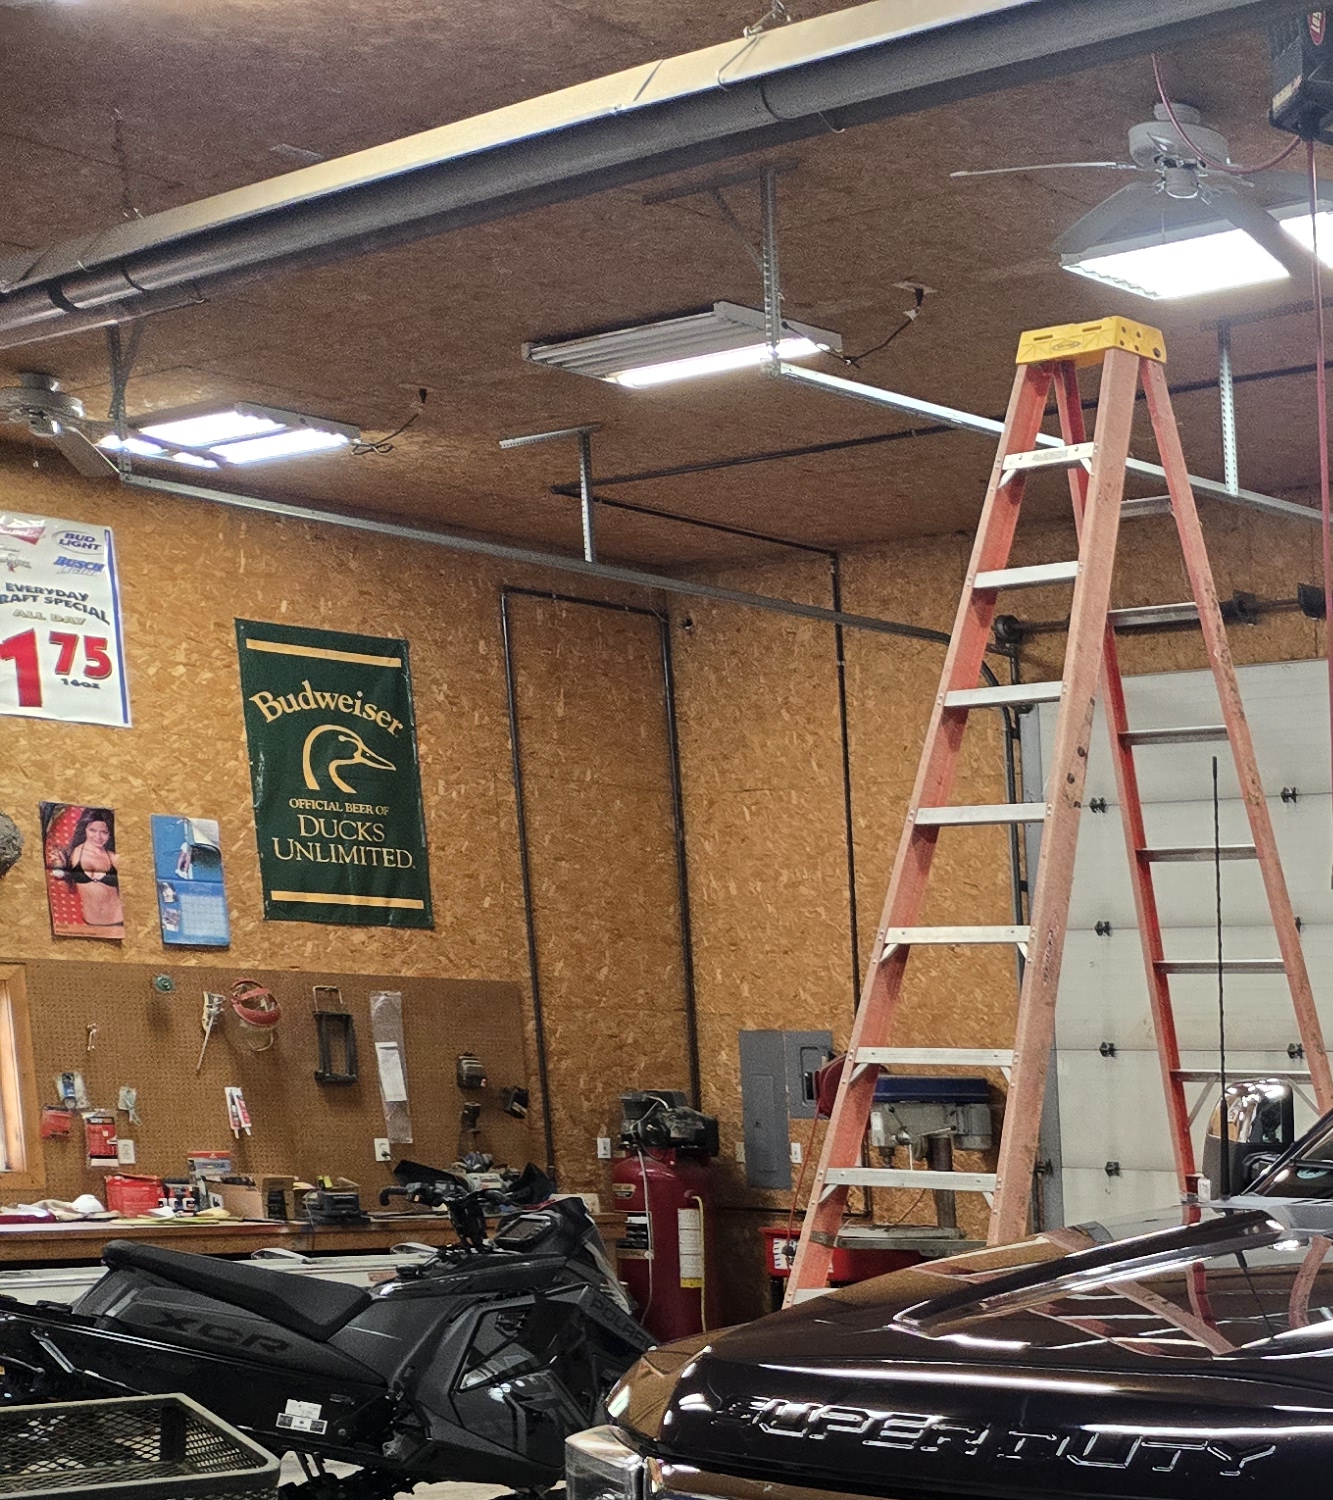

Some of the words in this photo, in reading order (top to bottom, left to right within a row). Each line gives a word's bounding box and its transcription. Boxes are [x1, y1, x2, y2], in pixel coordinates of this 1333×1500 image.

[59, 538, 102, 551] LIGHT
[64, 532, 96, 543] BUD
[53, 555, 105, 572] BUSCH
[5, 582, 89, 601] EVERYDAY
[13, 608, 47, 621] ALL
[50, 613, 86, 626] DAY
[44, 596, 110, 625] SPECIAL
[249, 679, 404, 738] Budweiser
[289, 798, 343, 812] OFFICIAL
[345, 802, 373, 815] BEER
[375, 805, 389, 816] OF
[297, 814, 385, 842] DUCKS
[272, 837, 413, 868] UNLIMITED
[152, 1311, 291, 1353] XCR
[590, 1296, 650, 1347] POLAR
[711, 1395, 990, 1457] SUPER
[997, 1426, 1277, 1476] DUTY
